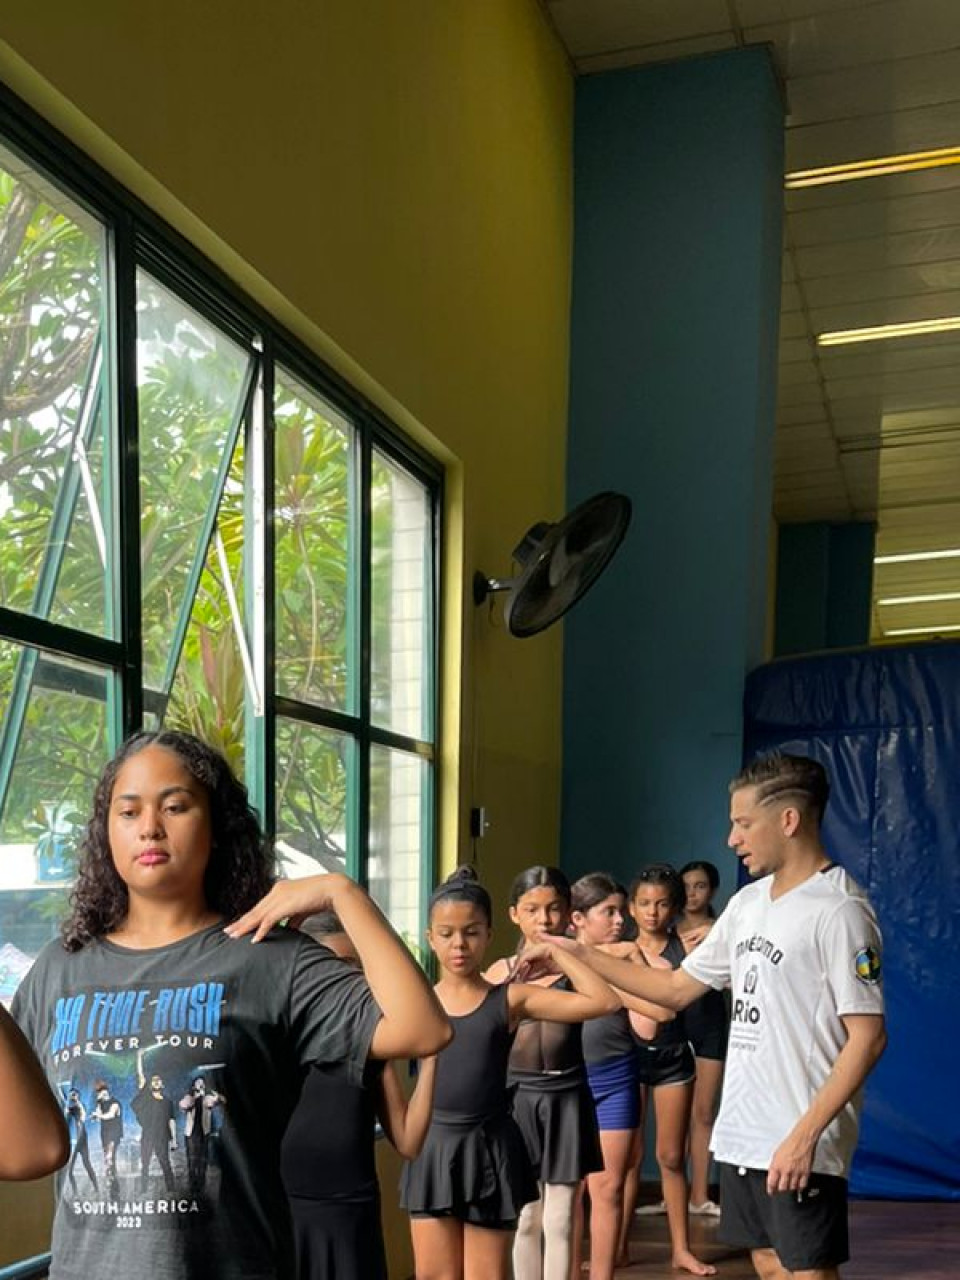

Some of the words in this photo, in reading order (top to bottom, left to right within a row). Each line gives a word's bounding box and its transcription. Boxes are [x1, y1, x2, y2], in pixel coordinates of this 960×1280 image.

[152, 982, 224, 1036] RUSH
[731, 998, 761, 1024] Rio
[155, 1034, 213, 1050] TOUR
[73, 1201, 119, 1215] SOUTH
[123, 1199, 199, 1215] AMERICA
